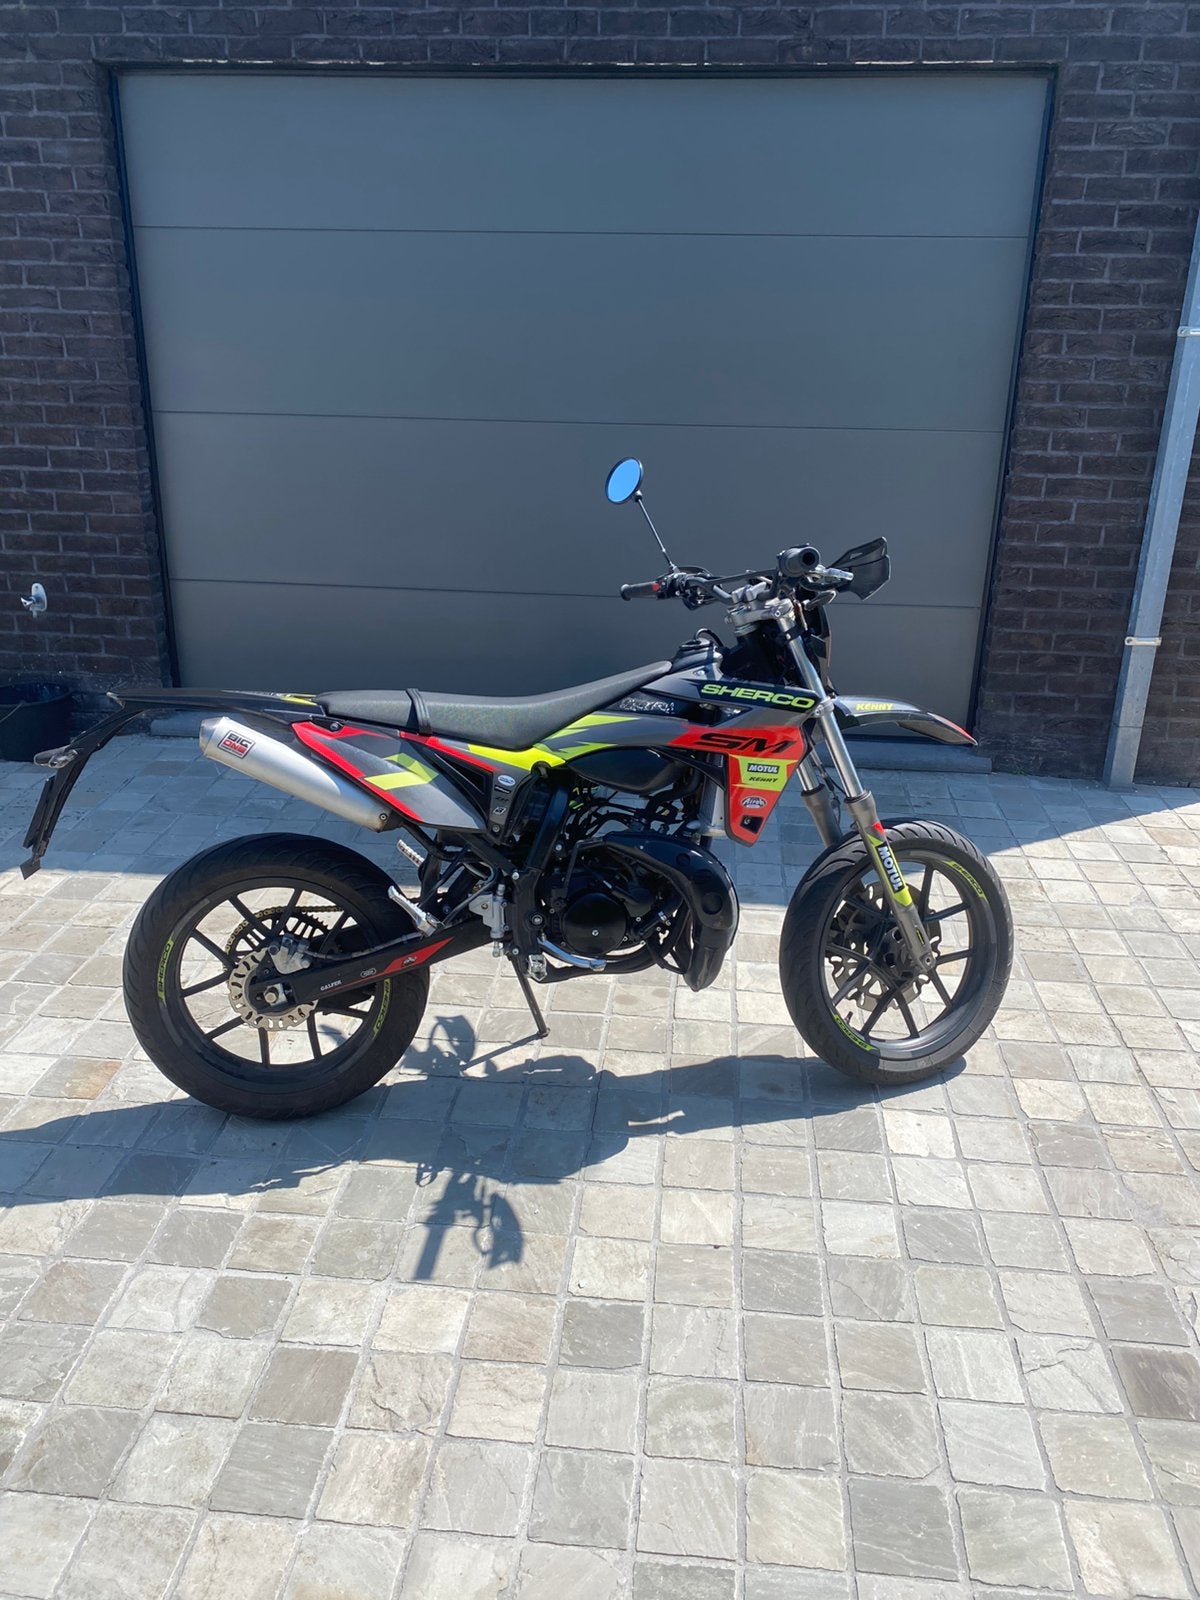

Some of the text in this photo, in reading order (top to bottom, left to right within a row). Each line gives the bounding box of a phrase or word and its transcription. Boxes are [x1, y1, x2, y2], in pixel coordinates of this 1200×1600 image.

[701, 684, 815, 709] SHERCO
[856, 702, 893, 711] KENNY
[227, 733, 252, 748] BIG
[696, 732, 797, 753] SM
[748, 764, 778, 773] MOTUL
[877, 846, 903, 891] MOTUL
[320, 980, 342, 991] GALFER
